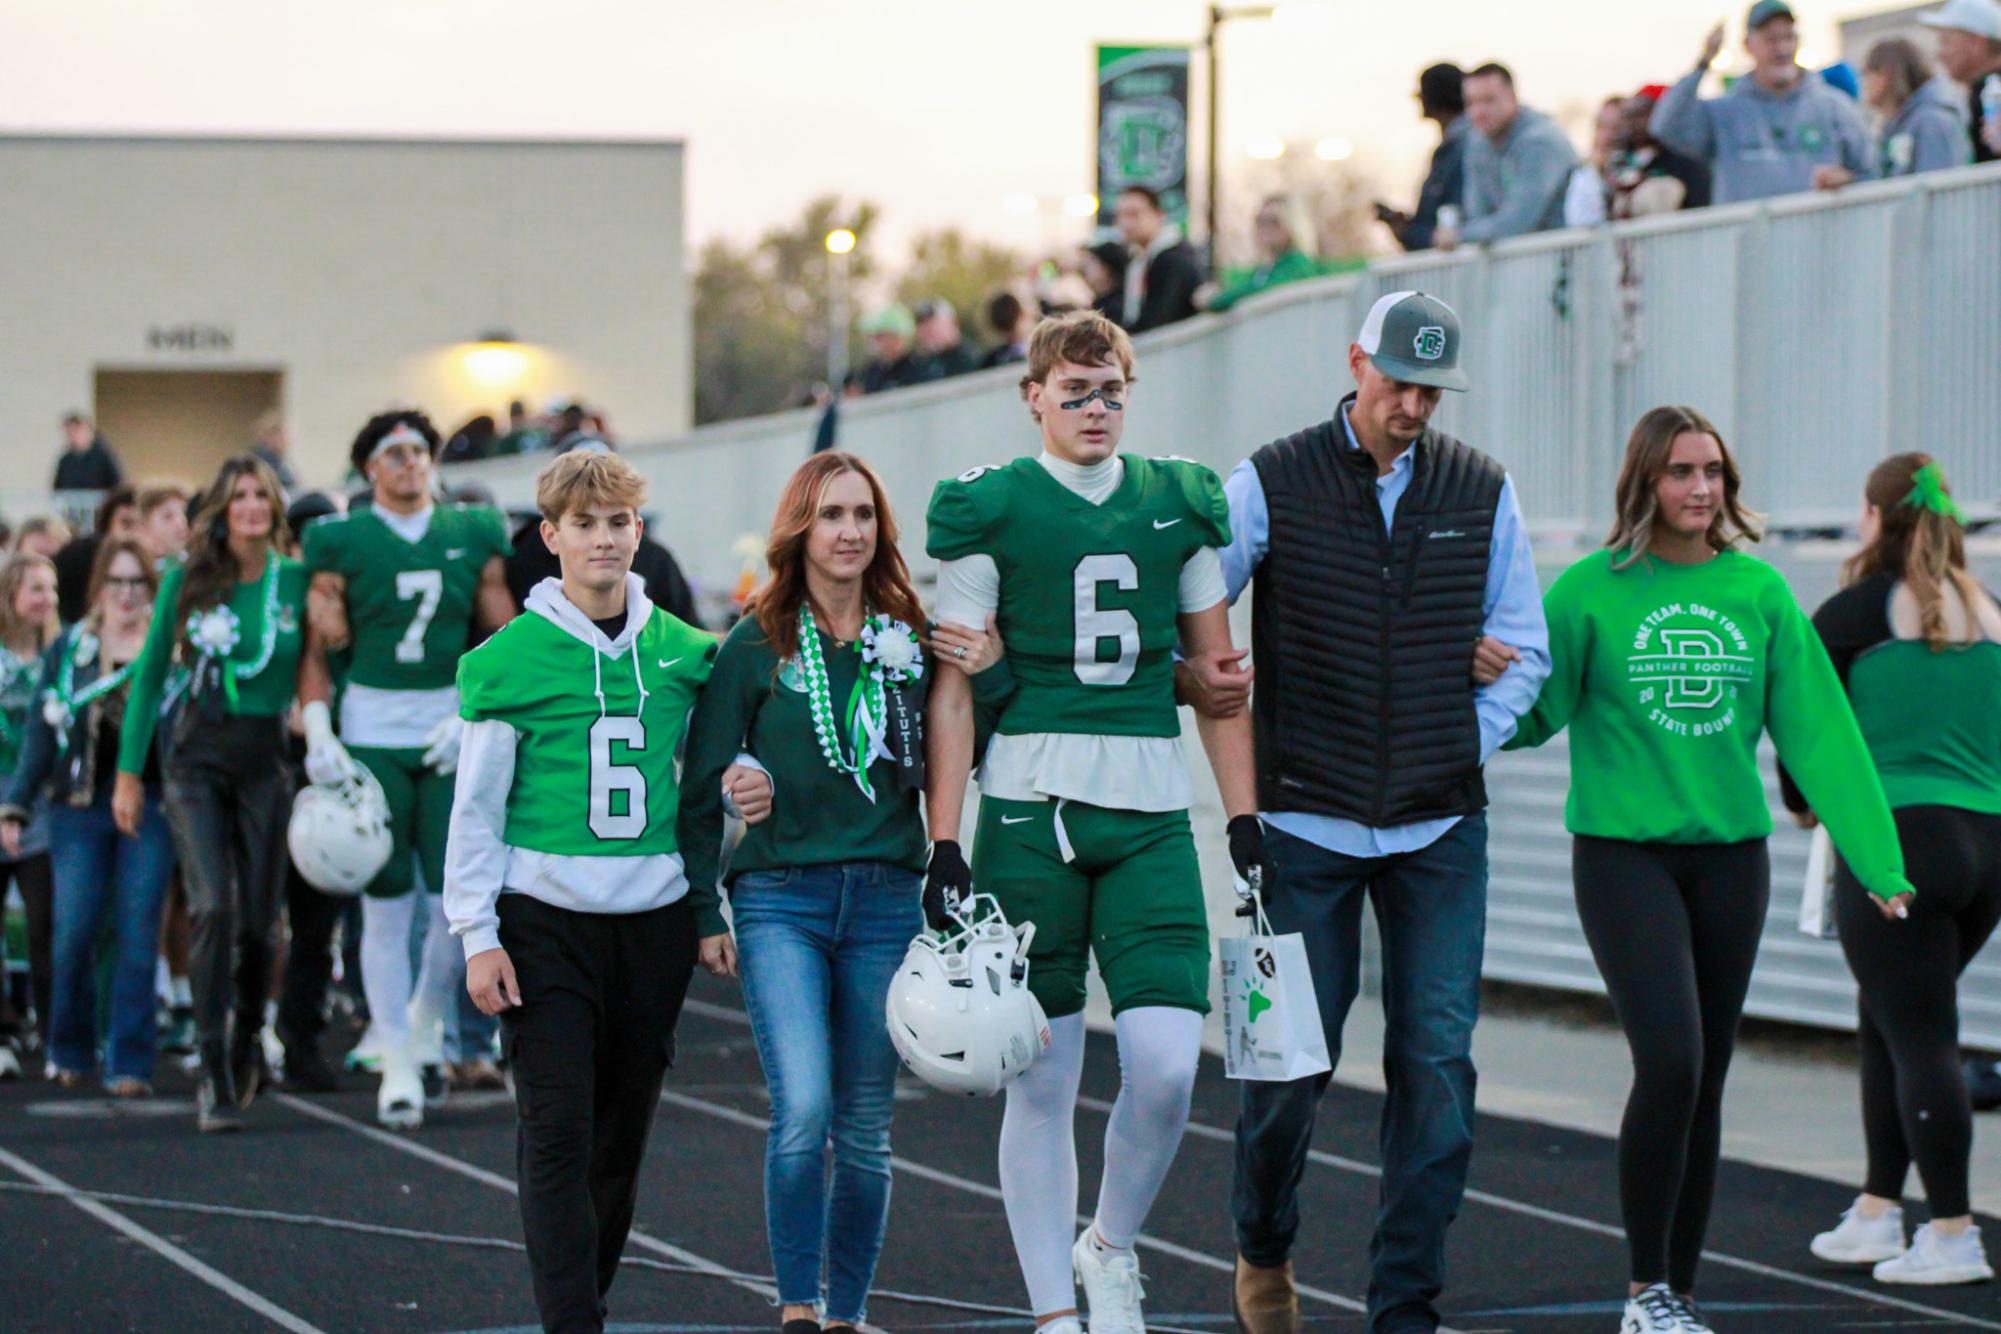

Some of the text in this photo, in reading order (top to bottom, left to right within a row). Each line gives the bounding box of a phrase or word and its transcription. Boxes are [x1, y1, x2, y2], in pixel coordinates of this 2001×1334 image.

[395, 569, 444, 664] 7
[1072, 552, 1141, 687] 6
[1633, 623, 1653, 650] ONE
[1689, 603, 1717, 621] ONE
[1718, 615, 1748, 651] TOWN
[1628, 662, 1687, 673] PANTHER
[1648, 708, 1688, 736] STATE
[587, 714, 650, 841] 6
